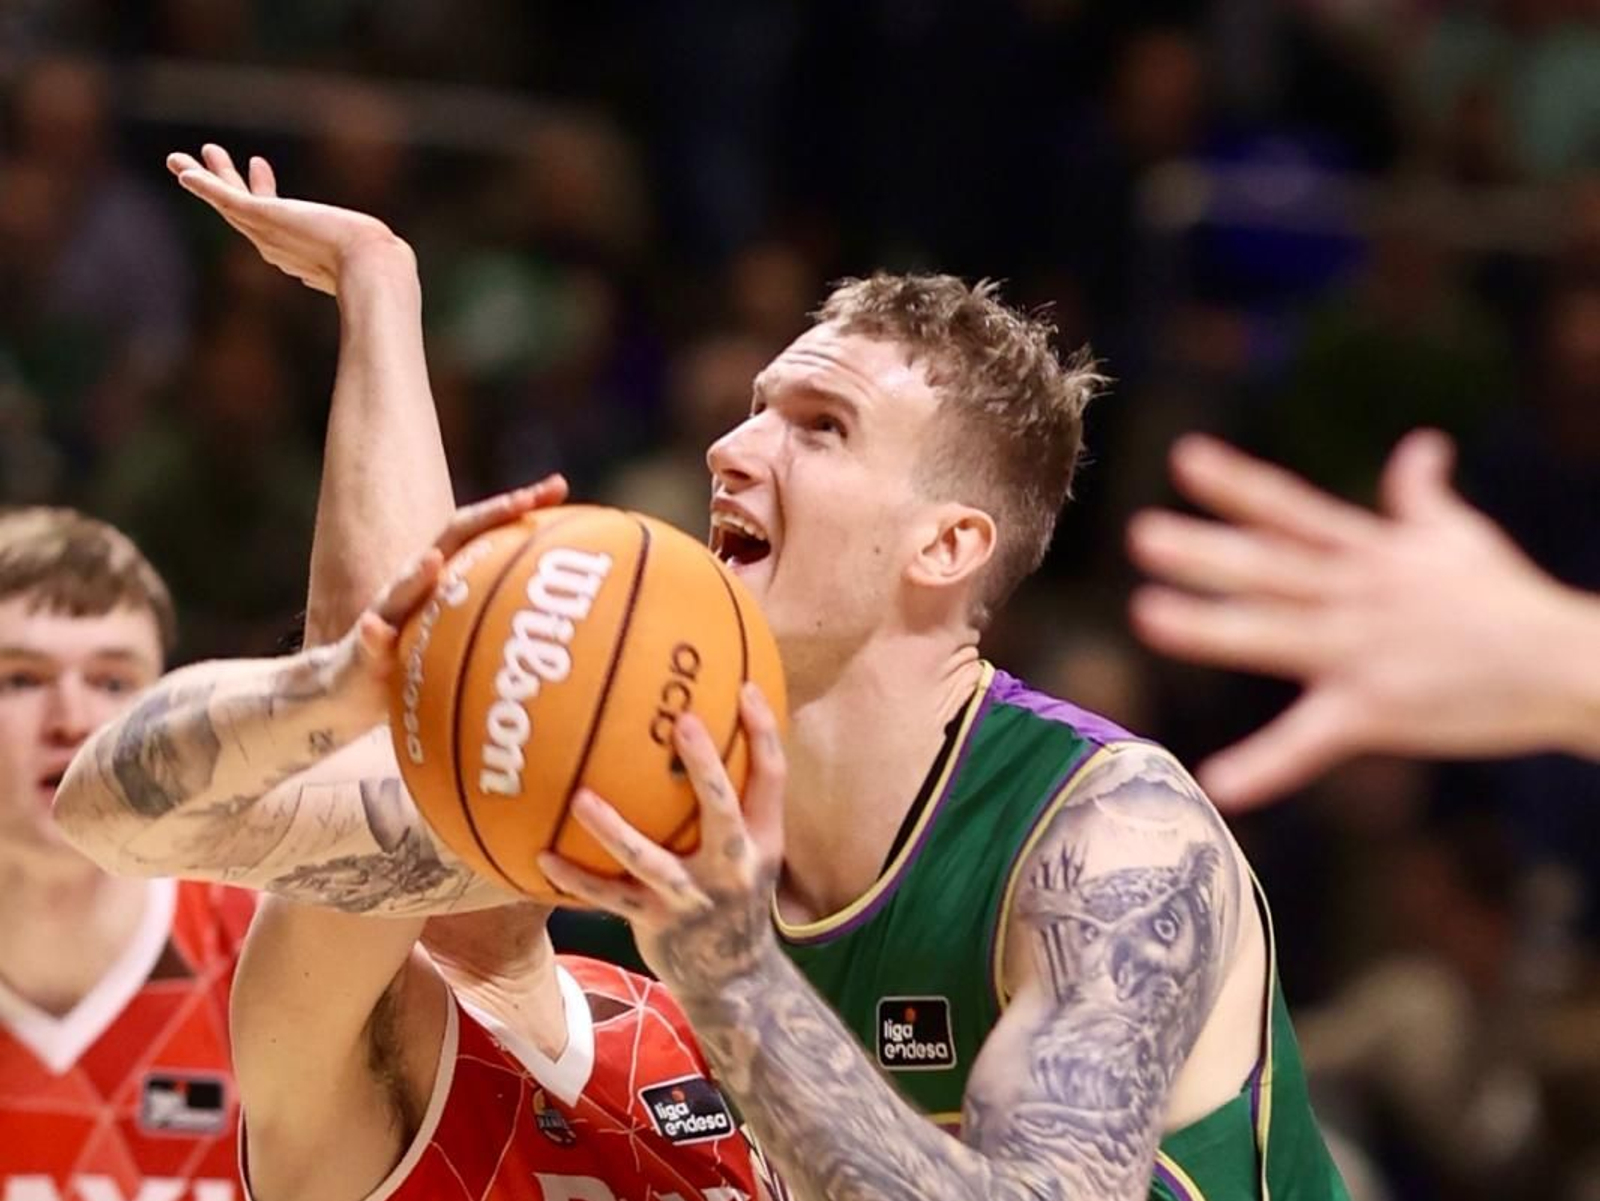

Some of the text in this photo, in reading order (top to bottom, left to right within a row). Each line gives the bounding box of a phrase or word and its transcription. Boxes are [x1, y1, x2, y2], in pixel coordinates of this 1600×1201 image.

[479, 547, 613, 797] Wilson
[883, 1018, 914, 1042] liga
[884, 1038, 949, 1060] endesa
[654, 1101, 690, 1121] liga
[664, 1113, 728, 1136] endesa
